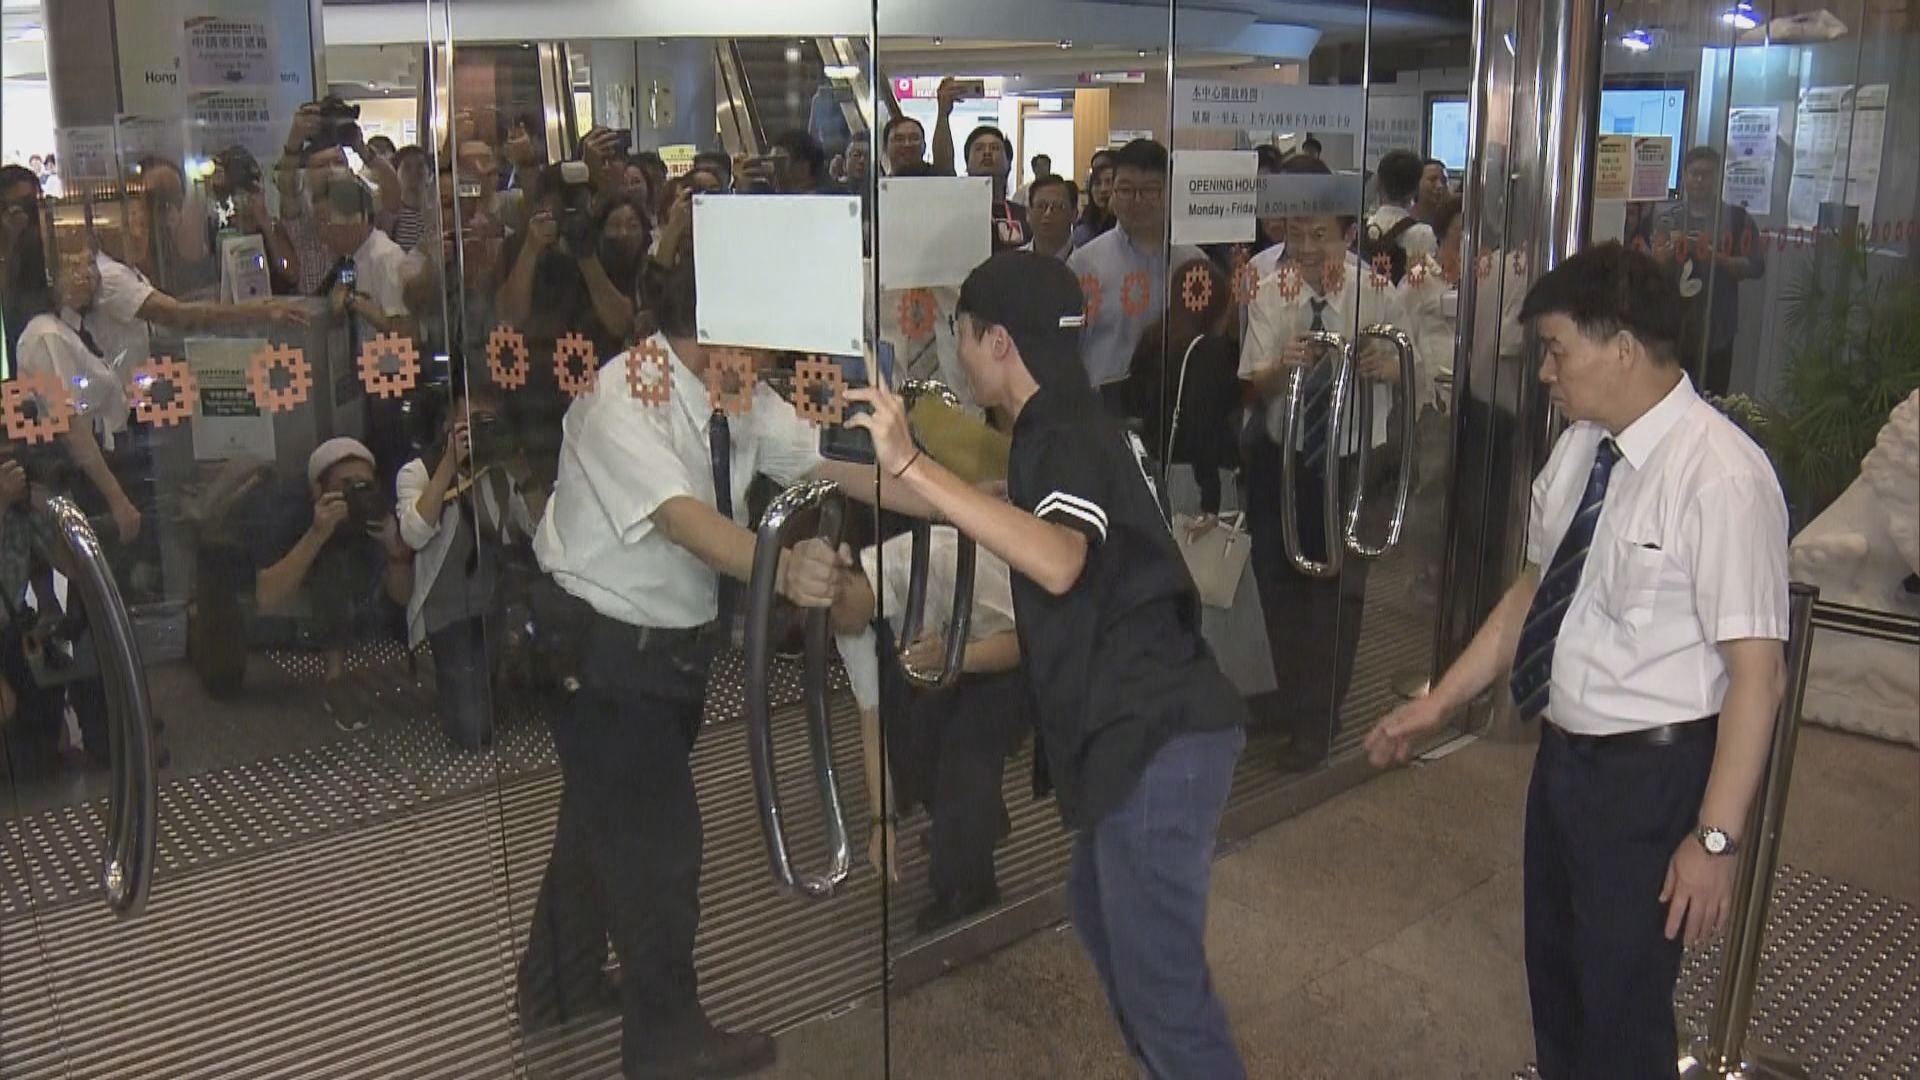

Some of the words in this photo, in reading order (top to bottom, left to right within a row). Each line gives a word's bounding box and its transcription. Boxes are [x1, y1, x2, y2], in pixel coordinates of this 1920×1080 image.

[145, 71, 176, 84] Hong
[1189, 180, 1233, 191] OPENING
[1235, 179, 1267, 191] HOURS
[1189, 203, 1224, 216] Monday
[1231, 201, 1257, 215] Friday
